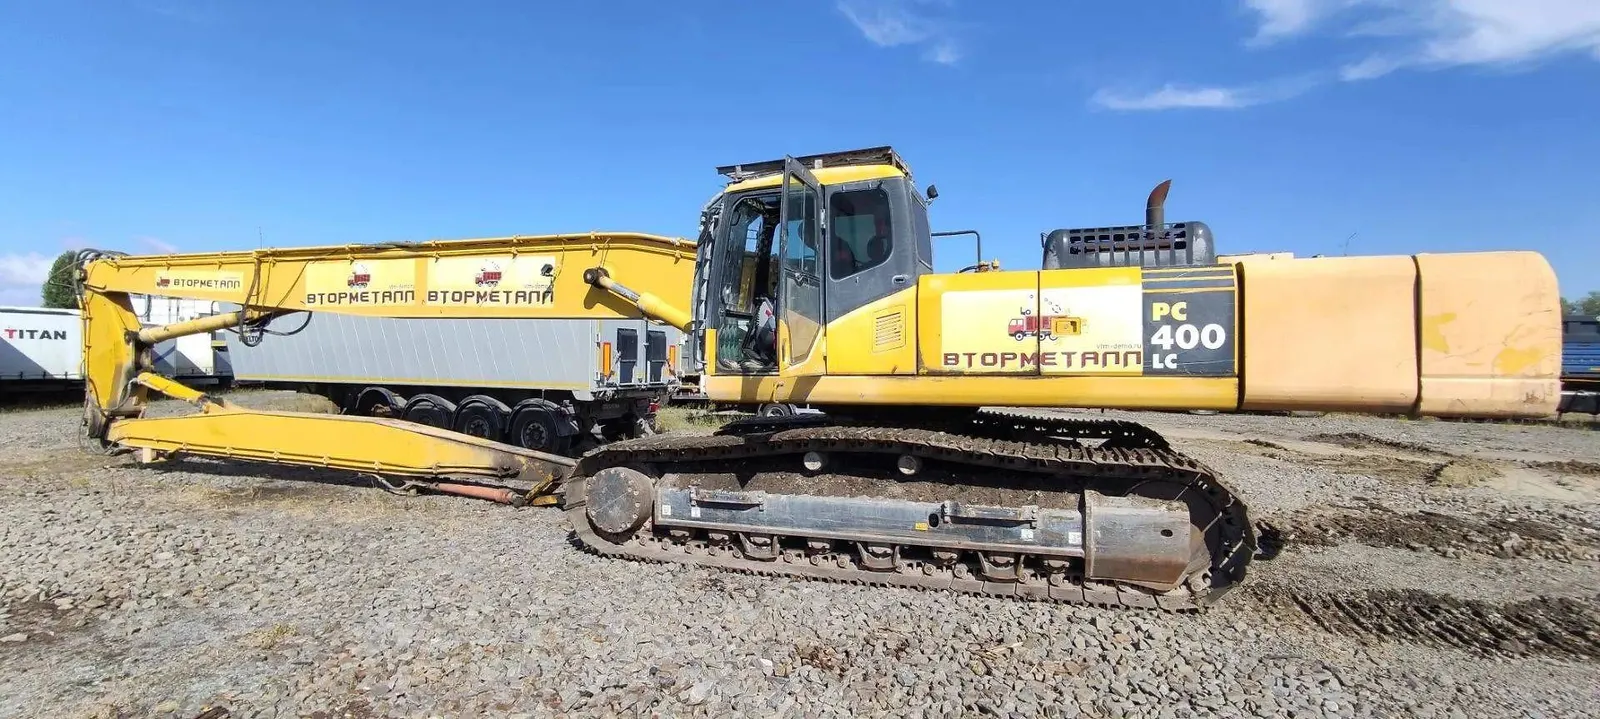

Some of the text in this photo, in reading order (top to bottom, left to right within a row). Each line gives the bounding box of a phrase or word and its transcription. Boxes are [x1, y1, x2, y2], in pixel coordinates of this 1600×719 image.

[1152, 301, 1187, 321] PC
[4, 329, 67, 340] TITAN
[1150, 323, 1226, 350] 400
[1152, 353, 1178, 369] LC
